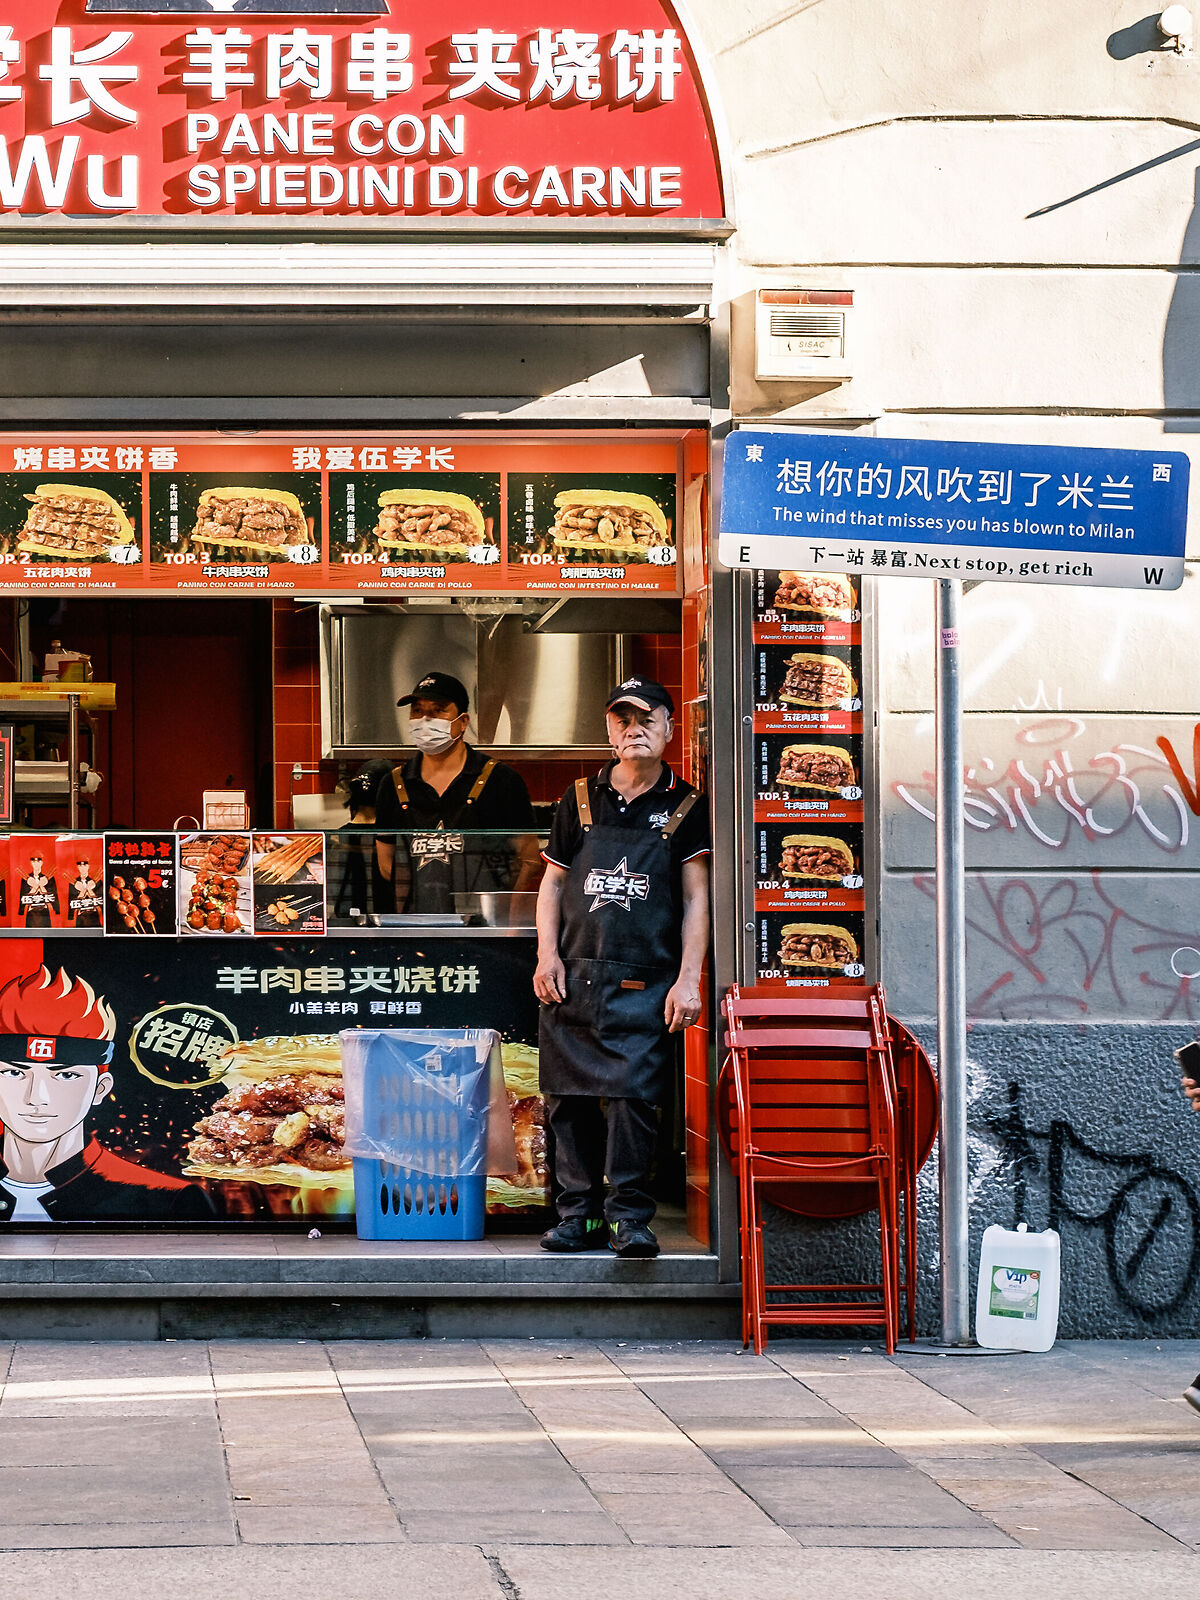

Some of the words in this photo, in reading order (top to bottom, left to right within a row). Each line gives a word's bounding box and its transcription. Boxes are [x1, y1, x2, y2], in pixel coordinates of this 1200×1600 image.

[181, 27, 416, 103] 羊肉串
[447, 28, 683, 103] 夹烧饼
[185, 112, 334, 156] PANE
[347, 112, 465, 156] CON
[185, 164, 417, 209] SPIEDINI
[427, 165, 481, 209] DI
[490, 164, 684, 209] CARNE
[13, 446, 179, 471] 烤串夹饼香
[292, 446, 456, 470] 我爱伍学长
[745, 444, 764, 463] 東
[1152, 463, 1173, 483] 西
[776, 458, 1135, 512] 想你的风吹到了米兰
[773, 506, 803, 523] The
[806, 507, 846, 526] wind
[849, 510, 884, 528] that
[888, 513, 944, 531] misses
[946, 517, 978, 534] you
[980, 516, 1011, 533] has
[1014, 518, 1066, 537] blown
[1068, 522, 1087, 538] to
[1089, 522, 1136, 540] Milan
[739, 546, 752, 563] E
[809, 546, 865, 567] 下一站
[965, 555, 1014, 575] stop,
[1019, 558, 1051, 576] get
[1054, 560, 1095, 577] rich
[23, 567, 92, 578] 五花肉夹饼
[202, 566, 269, 578] 牛肉串夹饼
[380, 566, 446, 578] 鸡肉串夹饼
[1144, 567, 1165, 585] W
[412, 836, 462, 854] 伍学长
[147, 869, 163, 889] 5
[587, 874, 648, 897] 伍学长
[21, 894, 55, 904] 伍学长
[69, 896, 104, 909] 伍学长
[215, 965, 481, 995] 羊肉串夹烧饼
[289, 1001, 359, 1015] 小羔羊肉
[369, 1001, 422, 1015] 更鲜香
[181, 1011, 215, 1031] 镇店
[29, 1039, 53, 1058] 伍
[139, 1017, 232, 1070] 招牌
